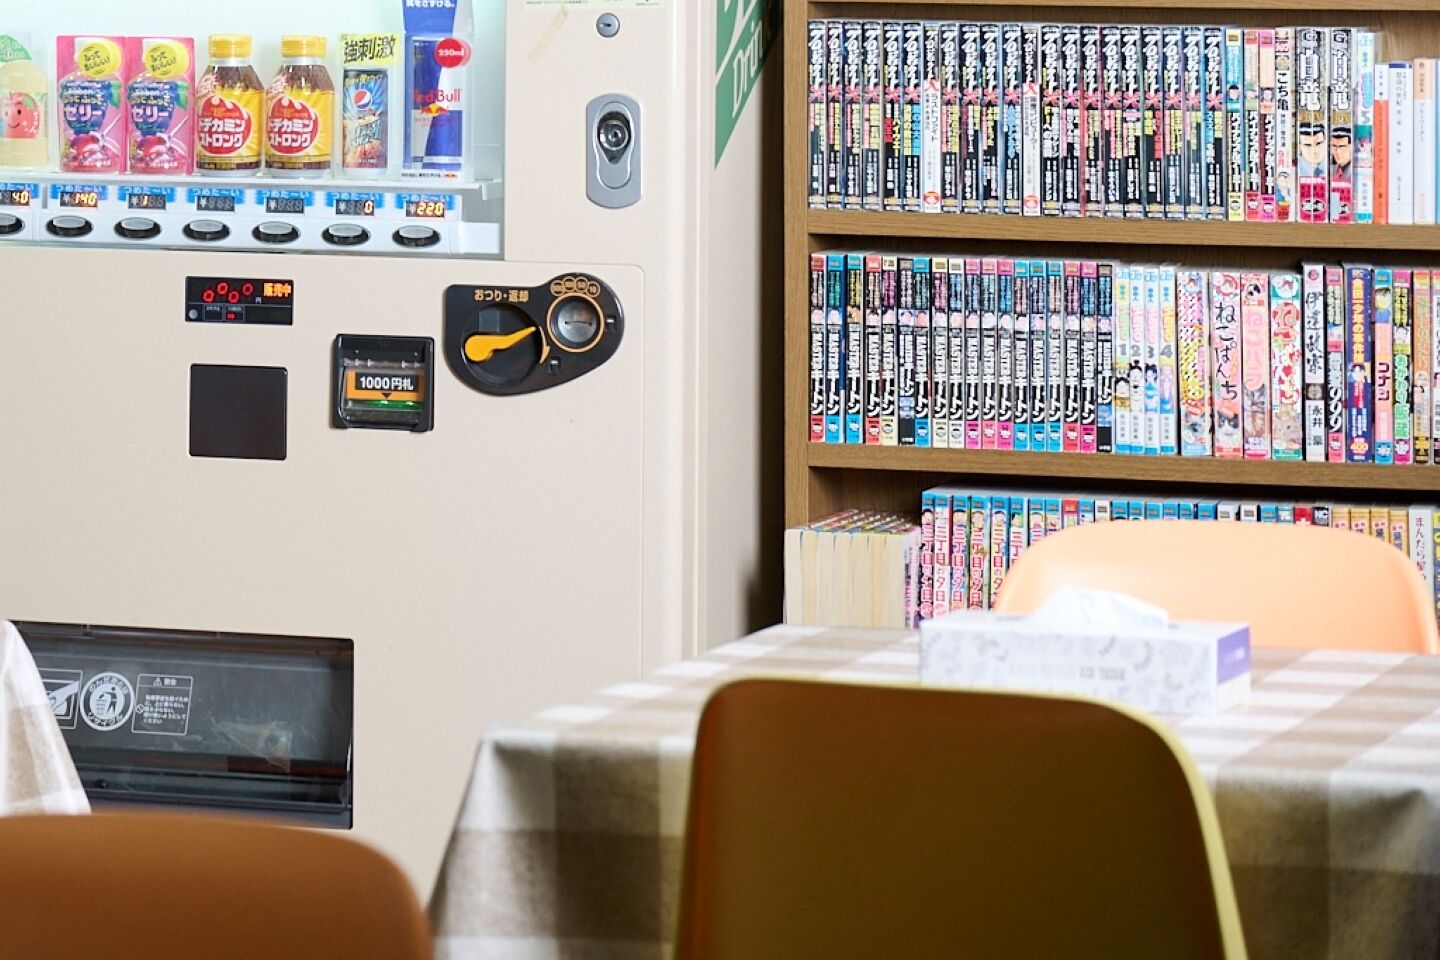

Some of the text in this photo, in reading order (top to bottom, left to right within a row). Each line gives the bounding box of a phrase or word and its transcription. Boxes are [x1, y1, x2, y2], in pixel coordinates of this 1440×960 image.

[343, 36, 396, 64] 強刺激
[438, 47, 466, 58] 250ml
[436, 88, 462, 103] Bull
[1277, 72, 1290, 111] こち亀
[64, 104, 103, 121] ゼリー
[131, 105, 169, 122] ゼリー
[474, 288, 529, 303] おつり・返却
[1119, 344, 1127, 356] 1
[1130, 344, 1141, 357] 2
[1147, 345, 1155, 359] 3
[1160, 344, 1173, 358] 4
[1214, 301, 1238, 401] ねこぱんち
[359, 376, 414, 390] 1000円札
[1312, 404, 1323, 428] 永井
[934, 524, 948, 602] 三丁目の夕日
[952, 525, 965, 602] 三丁目の夕日
[971, 526, 984, 603] 三丁目の夕日
